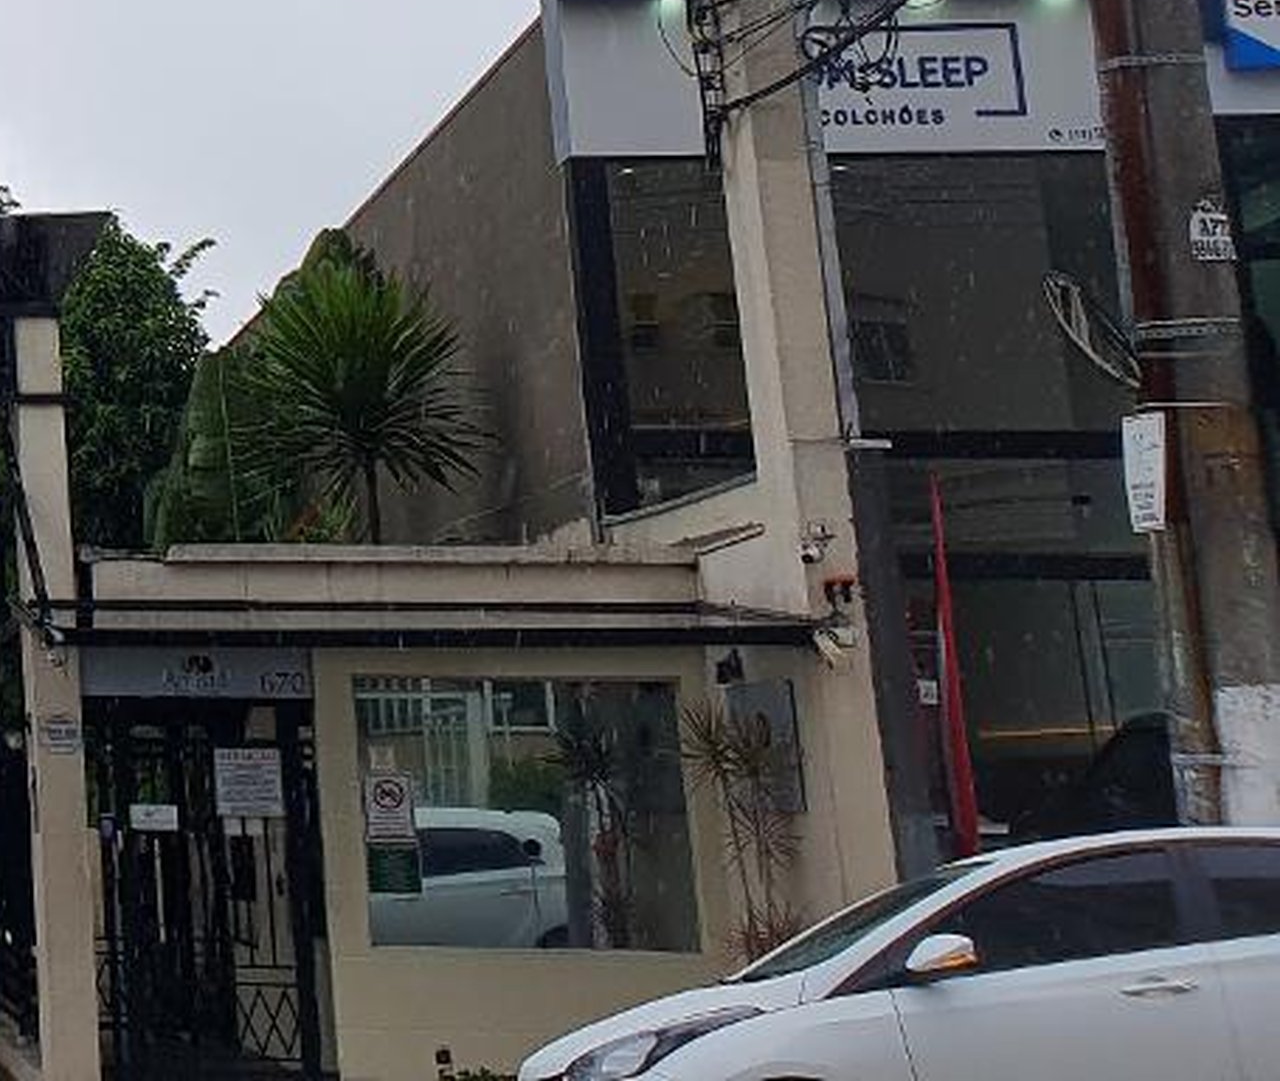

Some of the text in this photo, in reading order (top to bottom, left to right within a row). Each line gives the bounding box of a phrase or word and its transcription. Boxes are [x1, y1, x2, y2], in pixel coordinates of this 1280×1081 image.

[878, 55, 989, 88] SLEEP
[820, 105, 945, 126] COLCHÕES
[259, 671, 305, 695] 670
